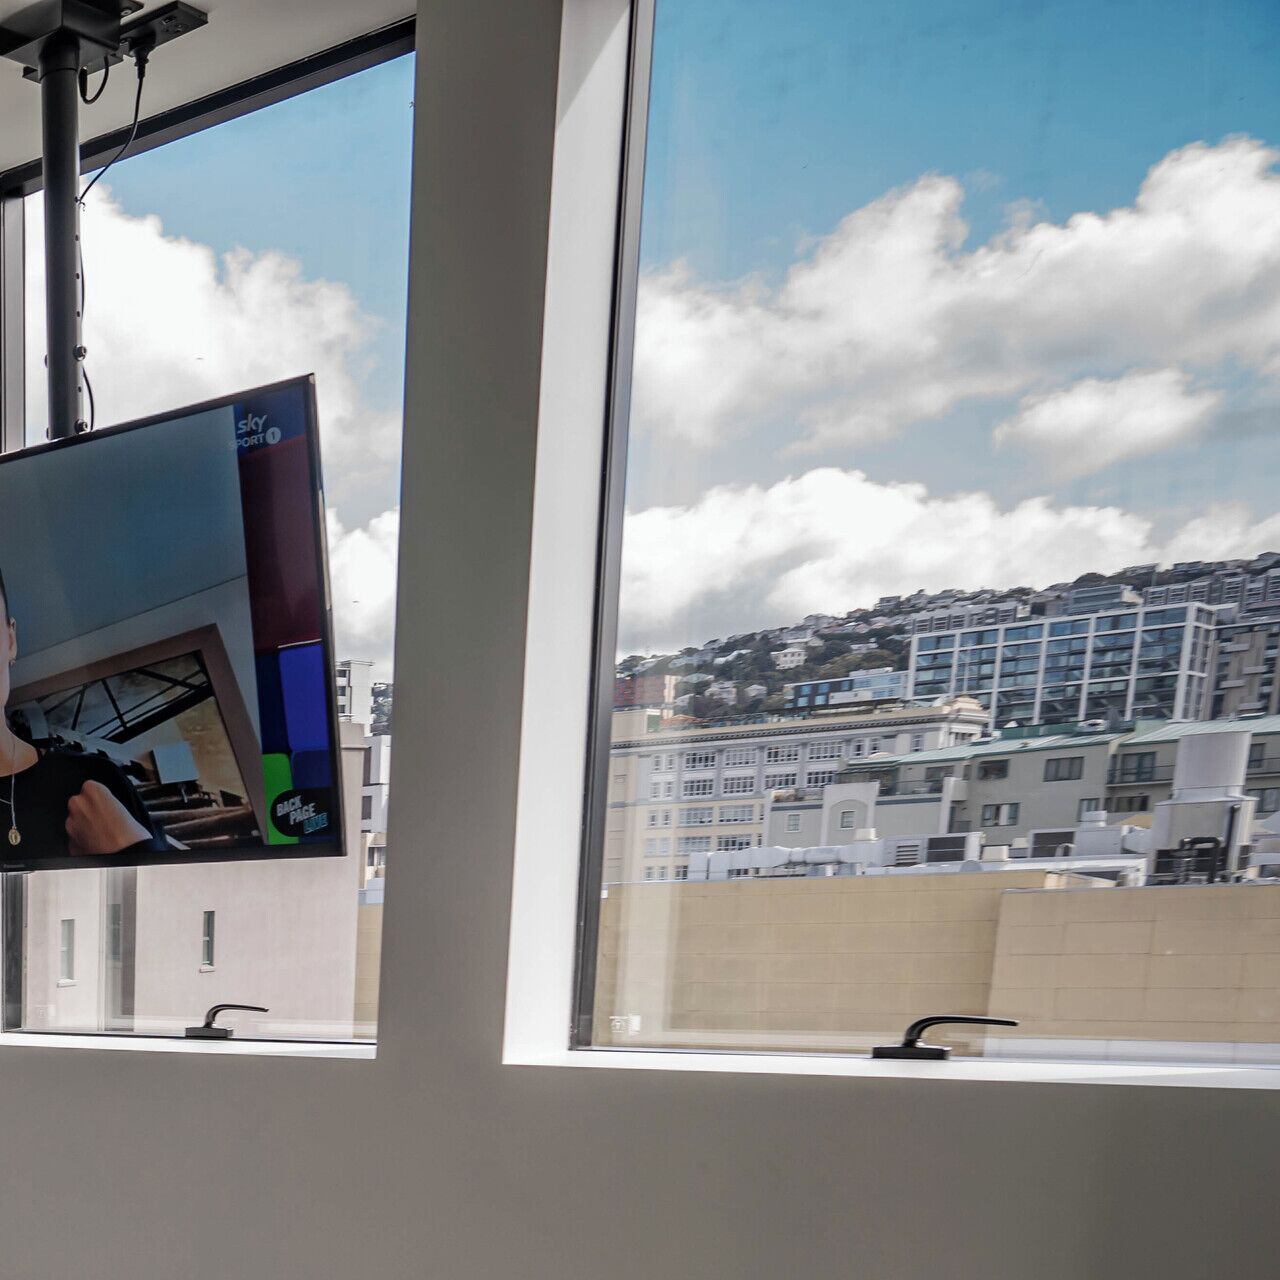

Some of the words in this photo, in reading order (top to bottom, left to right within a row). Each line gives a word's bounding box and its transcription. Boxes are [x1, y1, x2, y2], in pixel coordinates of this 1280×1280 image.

[237, 413, 268, 434] sky
[228, 433, 265, 451] SPORT
[276, 795, 302, 817] BACK
[289, 802, 316, 825] PAGE
